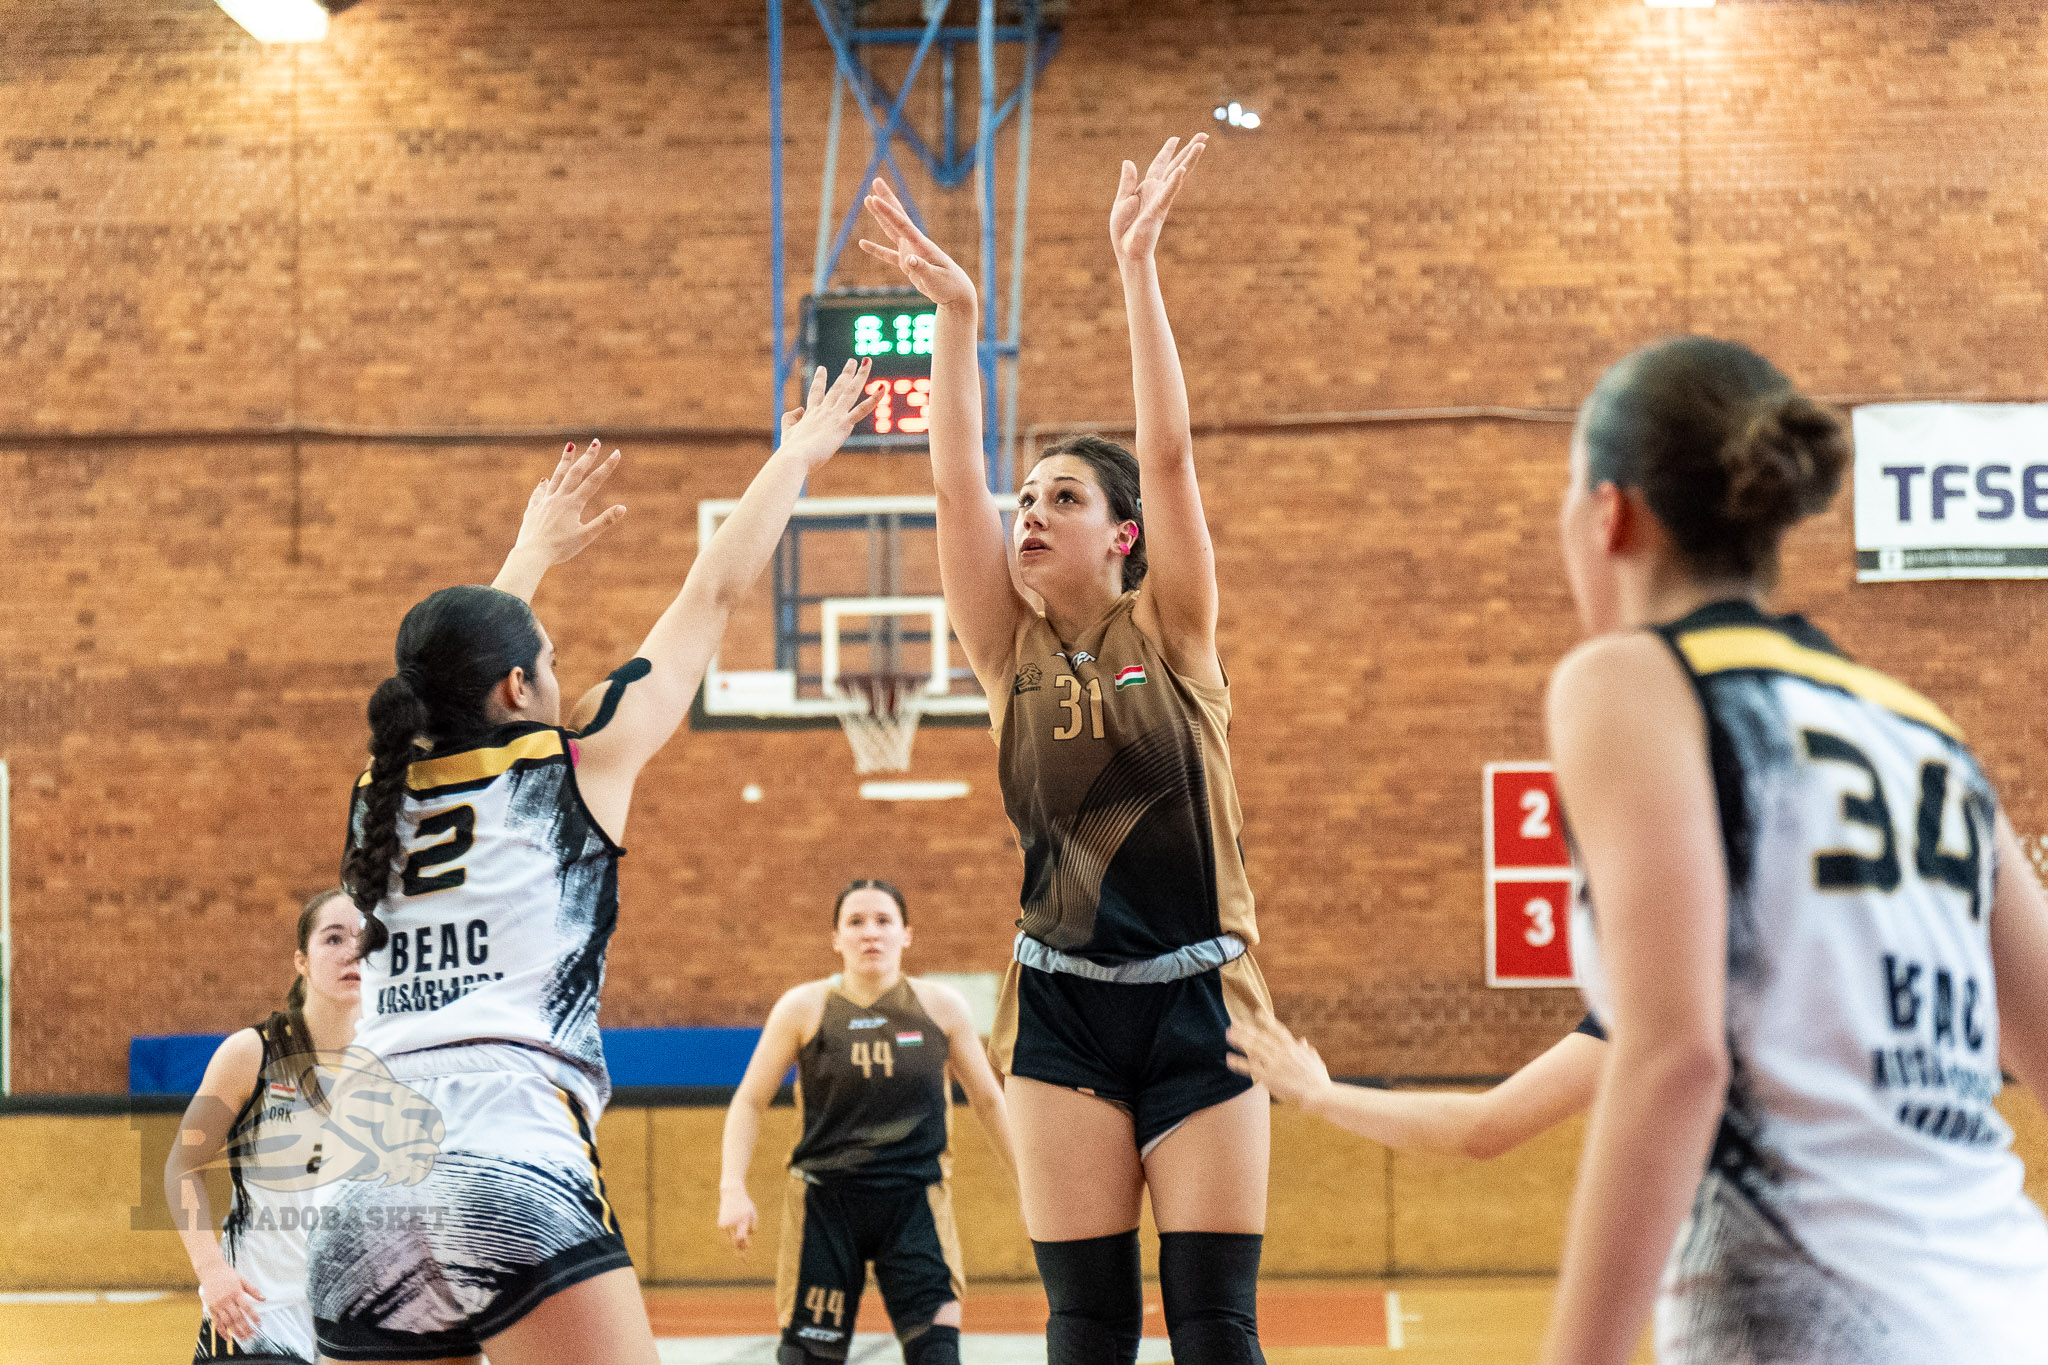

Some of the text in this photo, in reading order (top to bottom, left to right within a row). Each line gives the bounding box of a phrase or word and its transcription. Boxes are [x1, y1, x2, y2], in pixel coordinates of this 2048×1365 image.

[1882, 464, 2048, 521] TFSE
[1053, 674, 1105, 741] 31
[1520, 789, 1551, 839] 2
[1802, 728, 1981, 921] 34
[401, 803, 477, 897] 2
[389, 919, 489, 977] BEAC
[1524, 898, 1556, 948] 3
[851, 1041, 894, 1079] 44
[804, 1286, 845, 1327] 44
